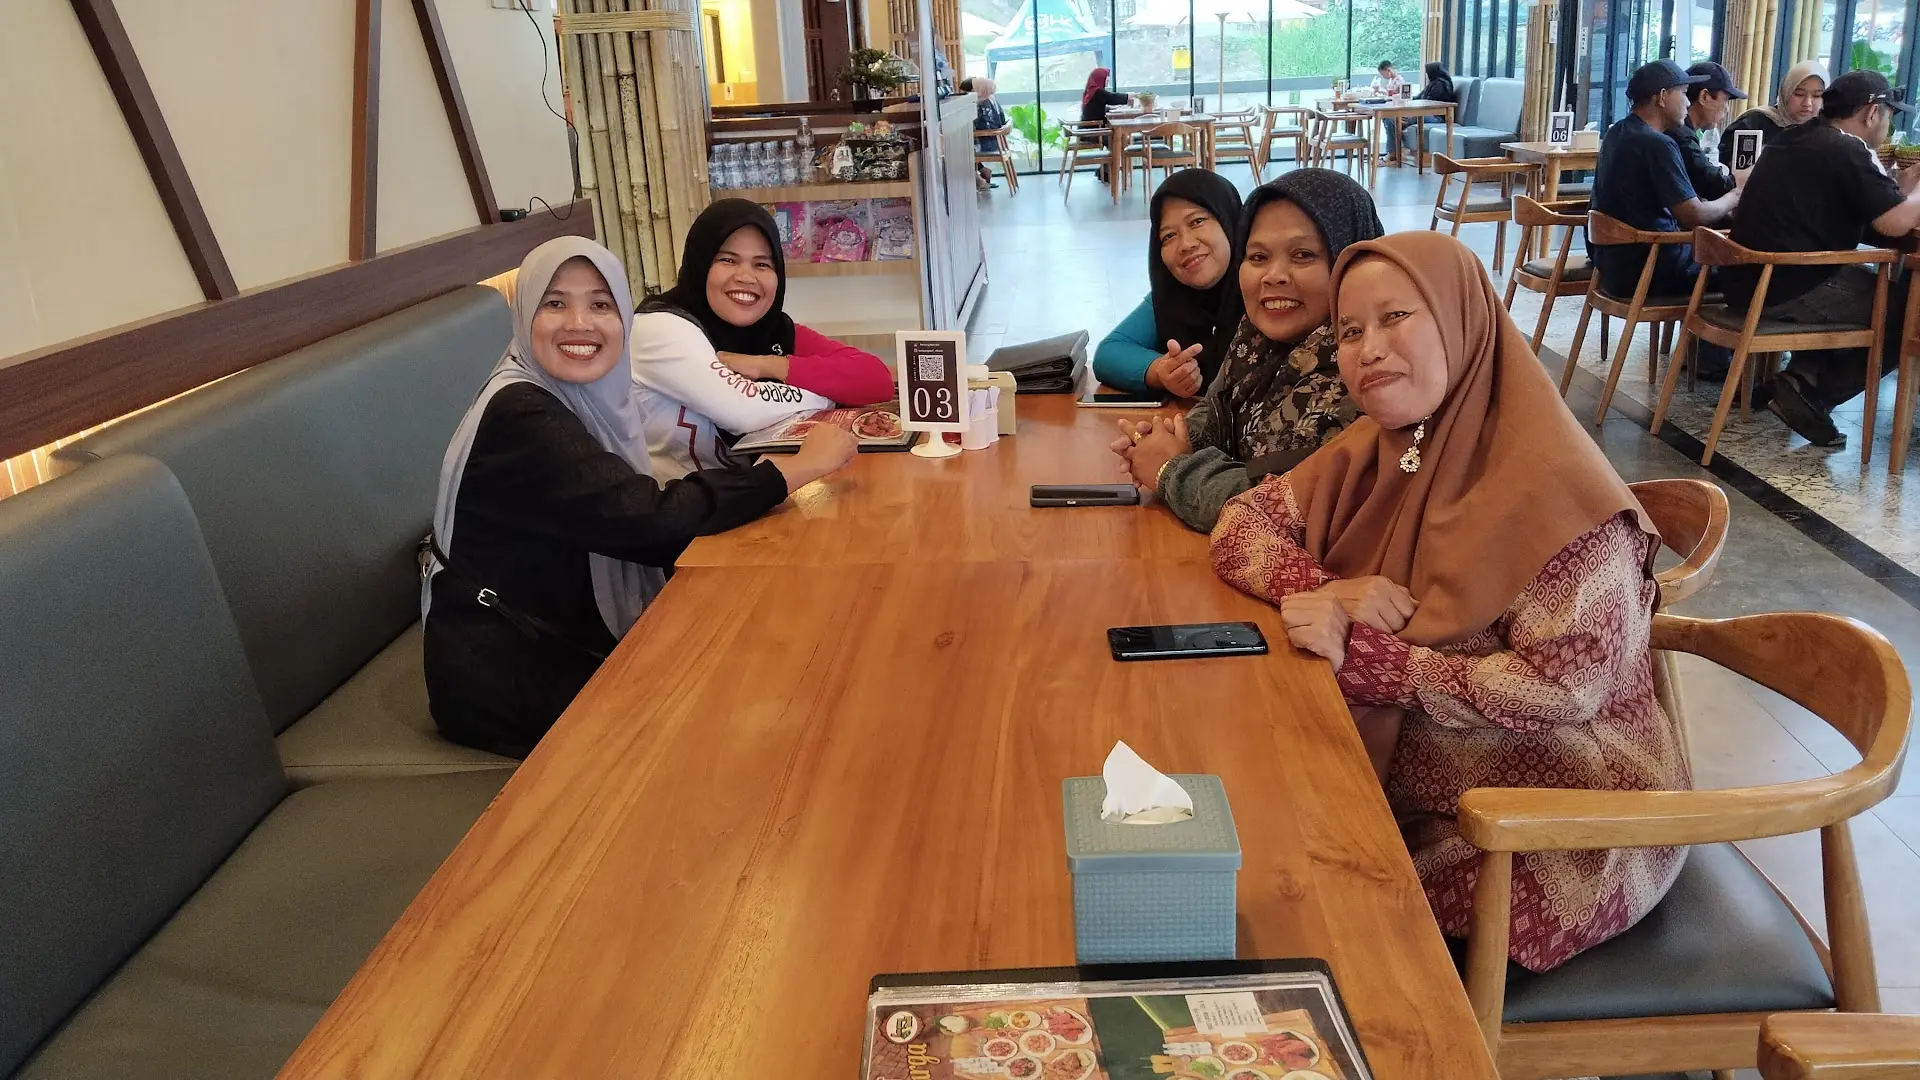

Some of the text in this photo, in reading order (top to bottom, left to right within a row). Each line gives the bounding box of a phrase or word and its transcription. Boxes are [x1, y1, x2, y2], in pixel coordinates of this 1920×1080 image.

[1553, 130, 1567, 141] 06
[1738, 154, 1753, 168] 04
[913, 387, 953, 419] 03
